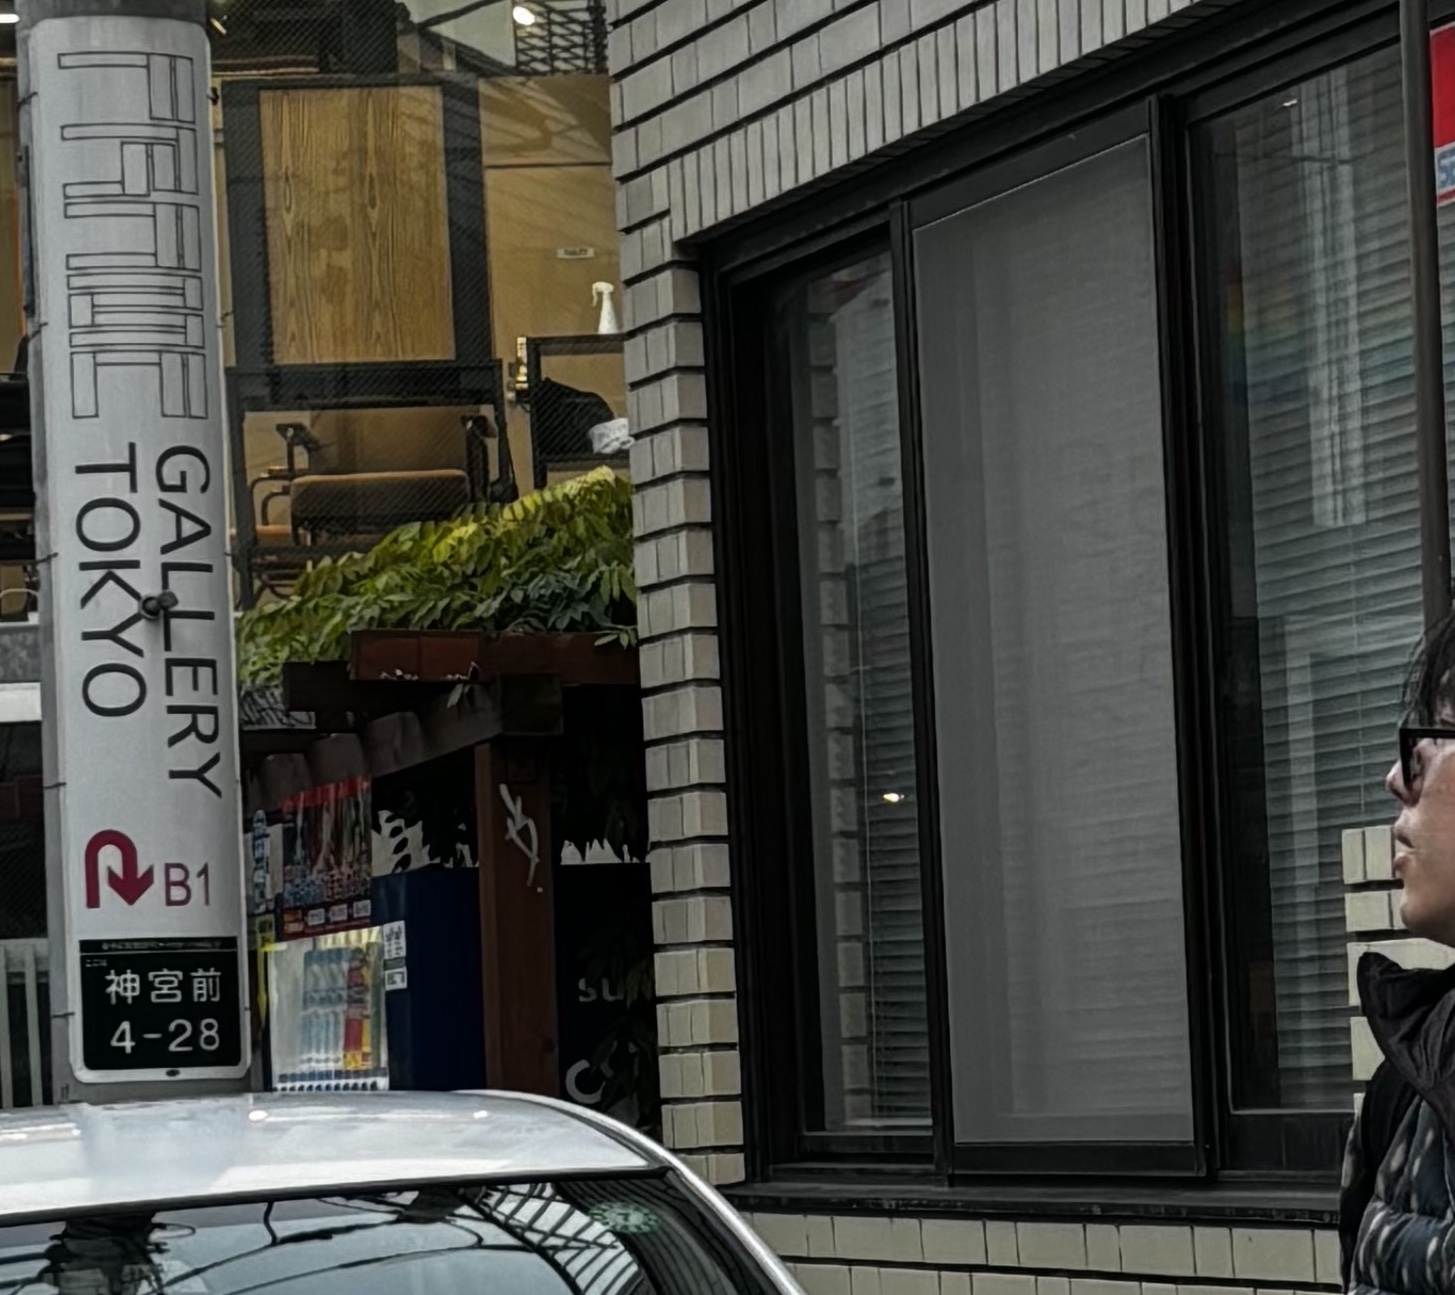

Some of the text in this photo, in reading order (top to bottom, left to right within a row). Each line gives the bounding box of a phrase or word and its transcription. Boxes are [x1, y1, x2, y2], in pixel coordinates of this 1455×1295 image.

[75, 441, 148, 718] TOKYO
[155, 444, 222, 800] GALLERY
[164, 863, 211, 907] B1
[104, 967, 222, 1005] 神宮前
[110, 1017, 220, 1054] 4-28
